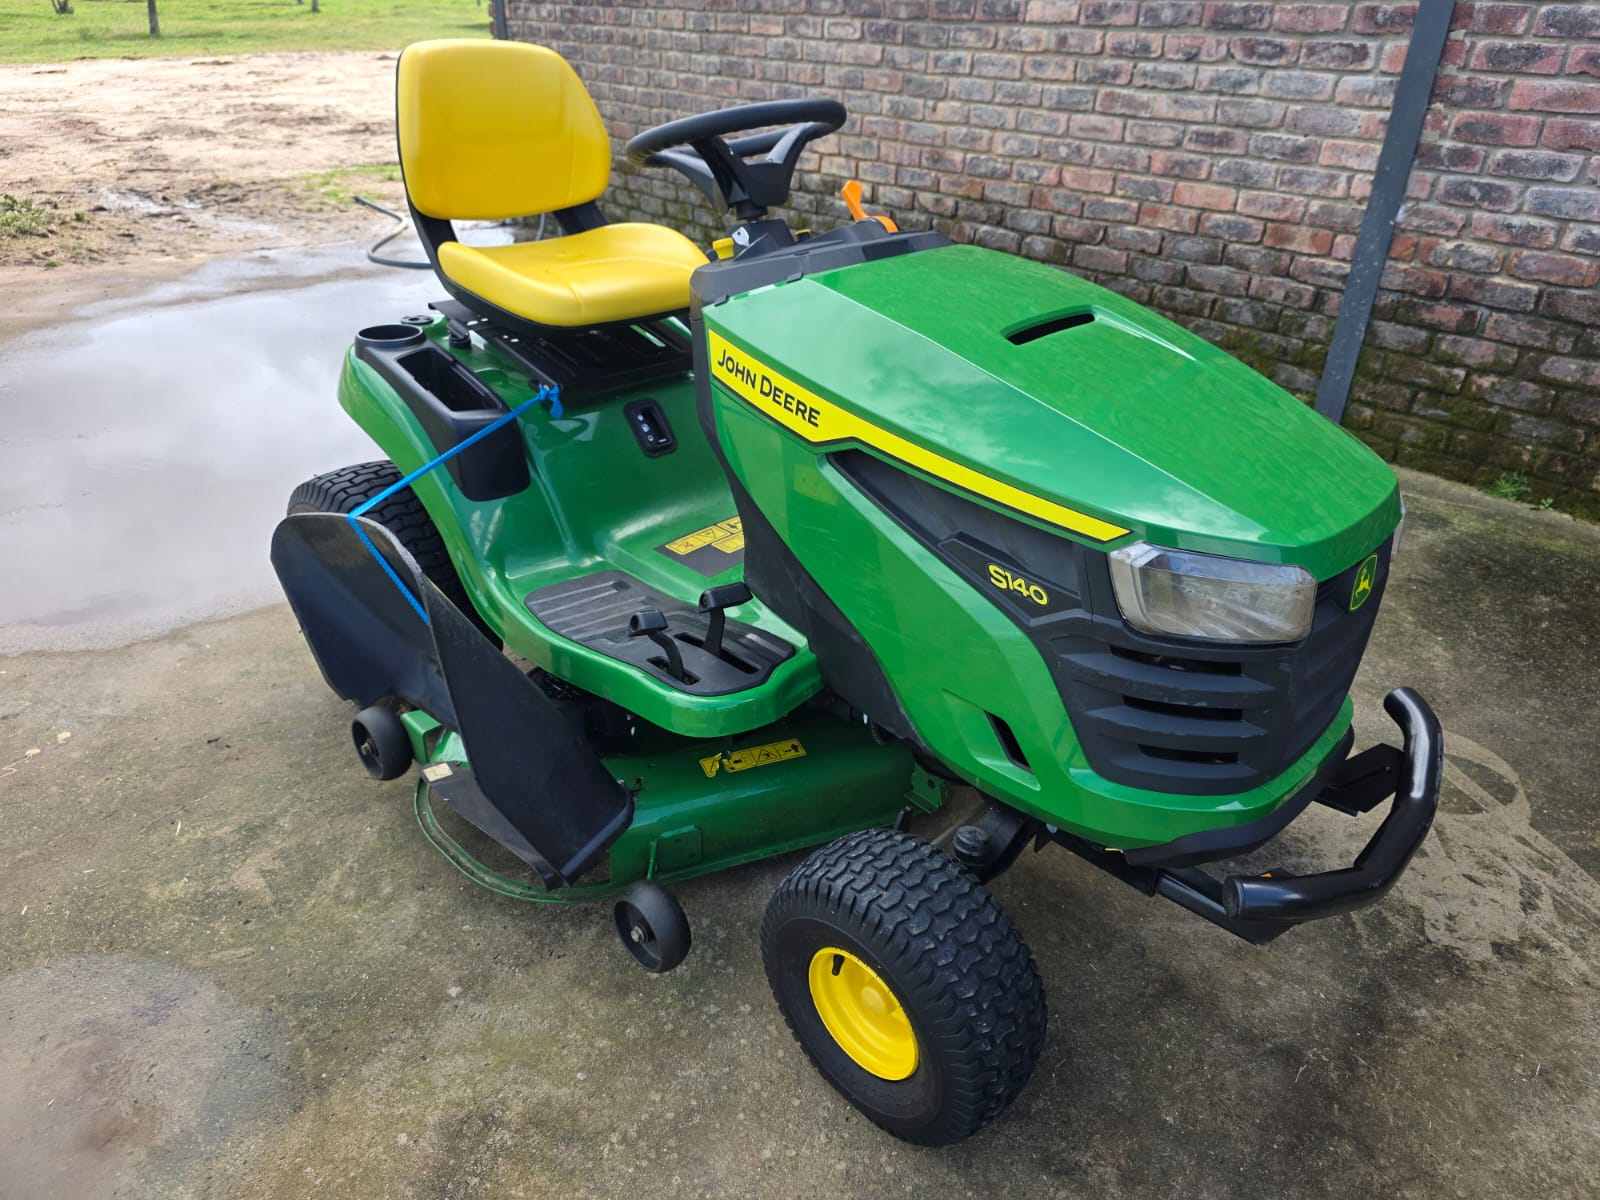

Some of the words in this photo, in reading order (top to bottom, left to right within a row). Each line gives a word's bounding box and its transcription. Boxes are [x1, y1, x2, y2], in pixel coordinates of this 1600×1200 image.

[717, 348, 757, 390] JOHN
[759, 374, 821, 428] DEERE
[988, 564, 1048, 605] S140
